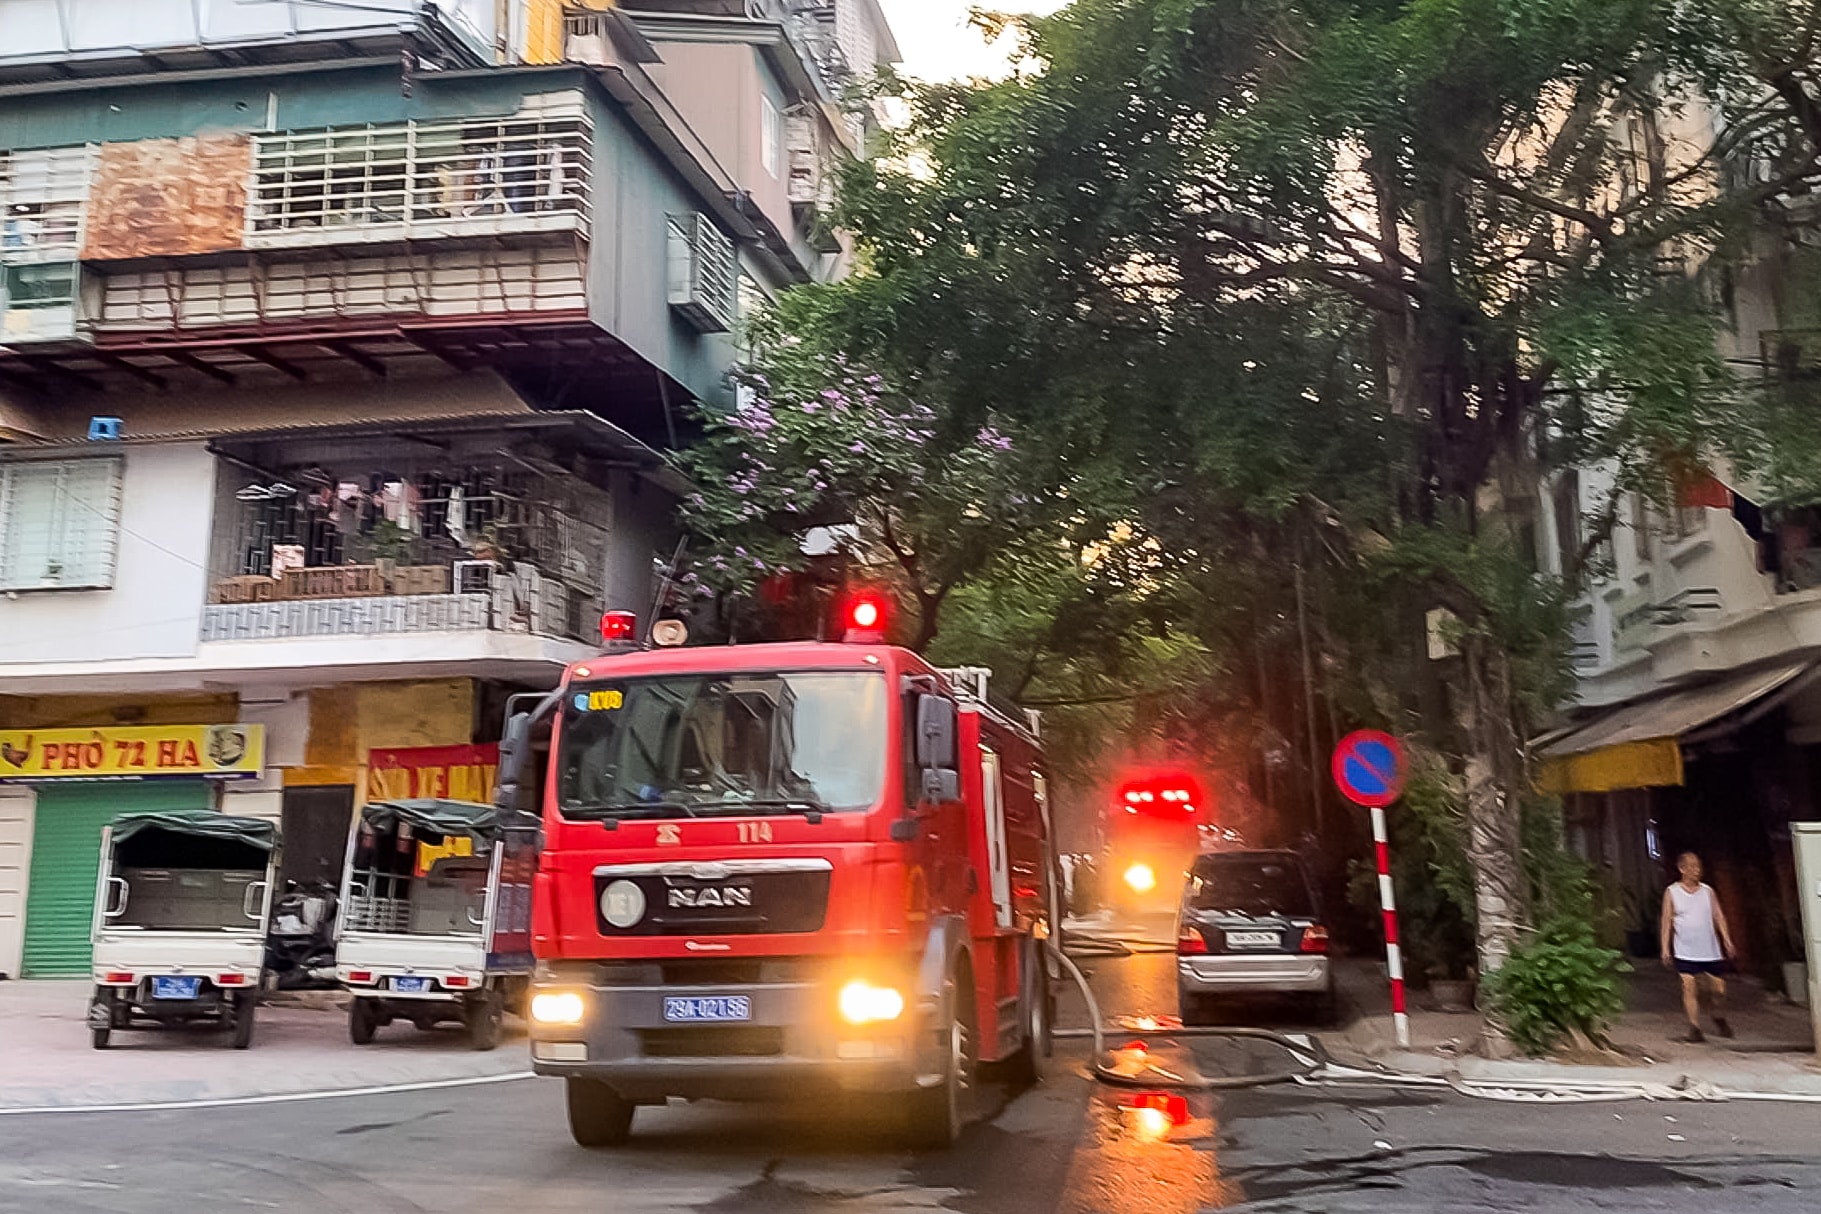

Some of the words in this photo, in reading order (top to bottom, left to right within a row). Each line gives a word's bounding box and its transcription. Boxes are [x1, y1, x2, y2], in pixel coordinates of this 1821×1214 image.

[115, 740, 146, 768] 72
[737, 821, 772, 843] 114
[668, 886, 752, 908] MAN
